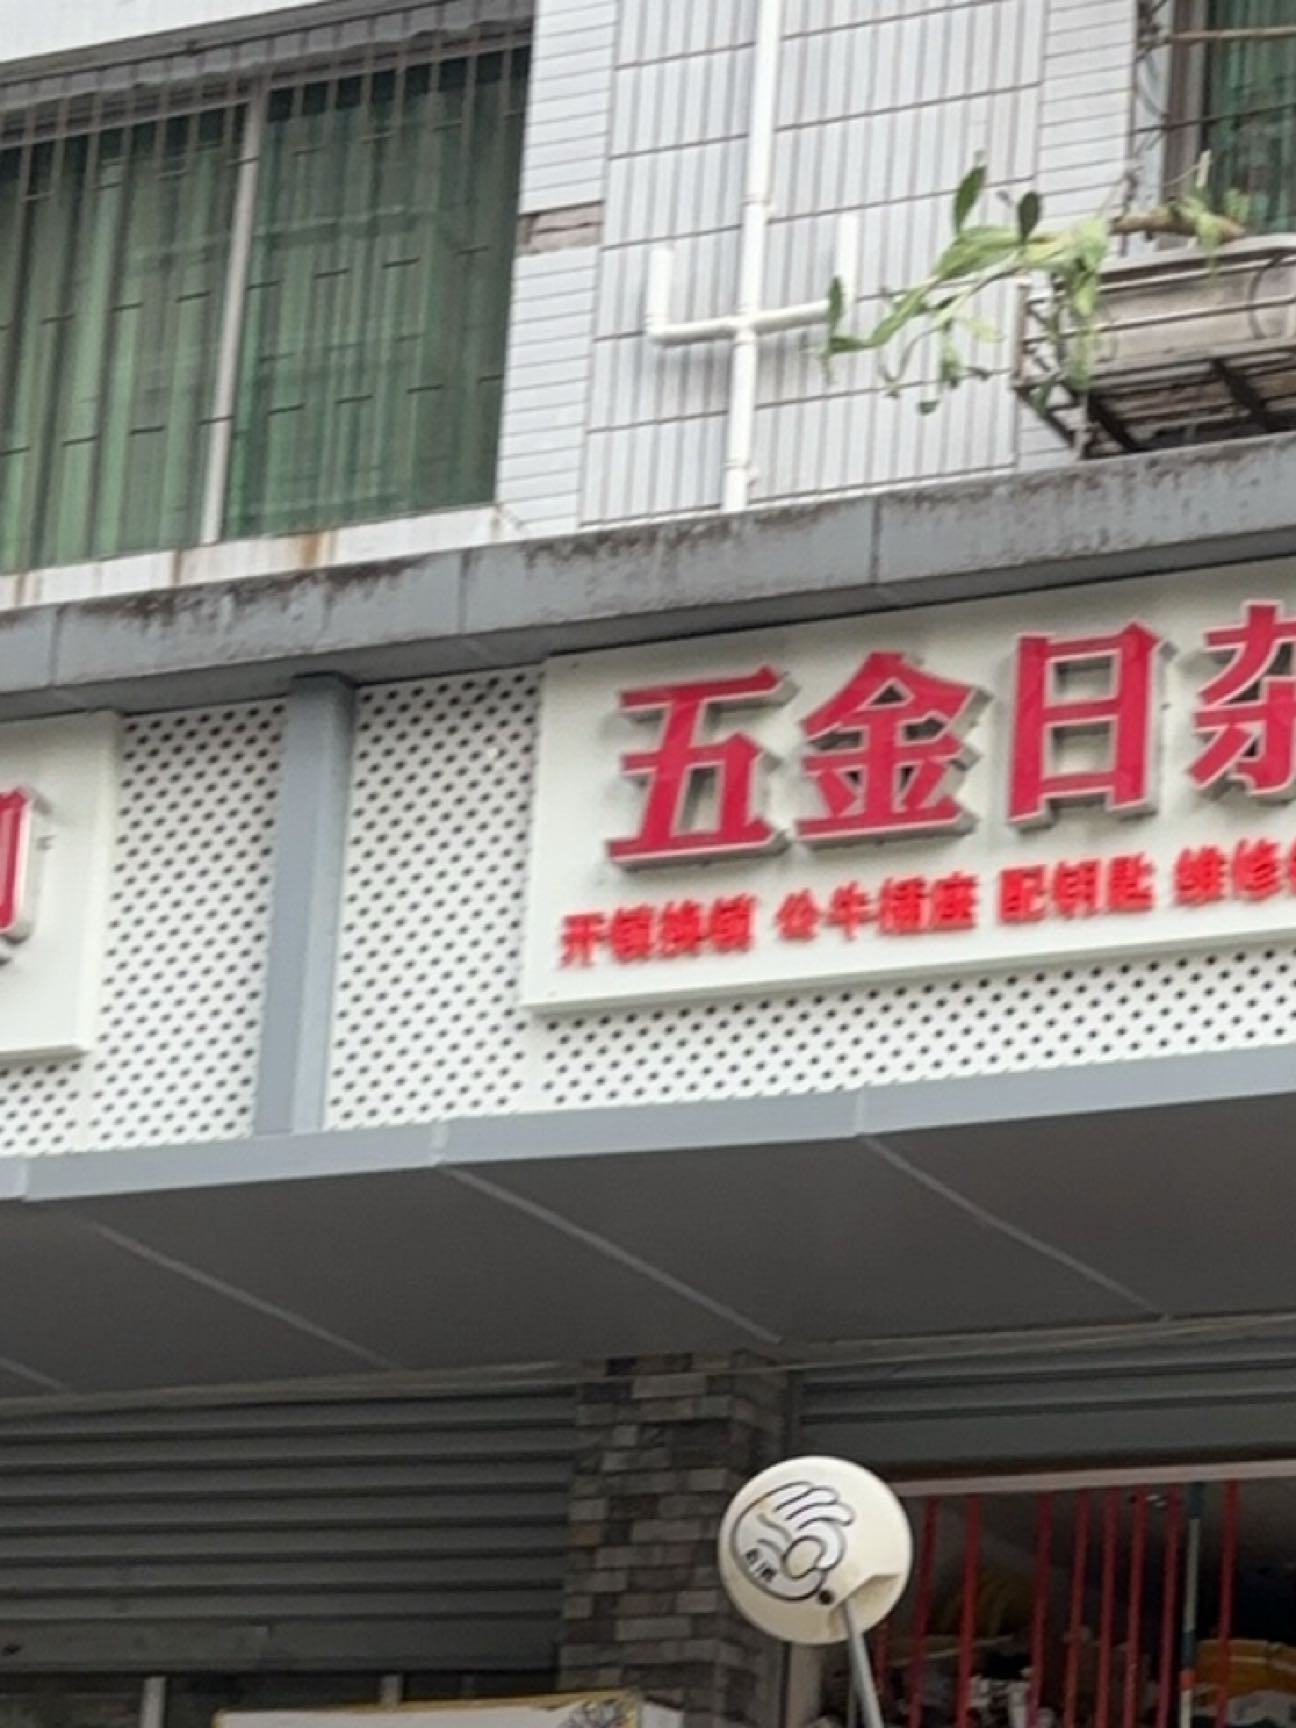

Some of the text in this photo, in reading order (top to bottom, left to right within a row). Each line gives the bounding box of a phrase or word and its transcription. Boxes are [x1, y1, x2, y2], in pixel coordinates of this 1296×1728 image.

[560, 891, 760, 967] 开锁换锁
[774, 869, 981, 942] 公牛插座
[996, 852, 1158, 925] 配钥匙
